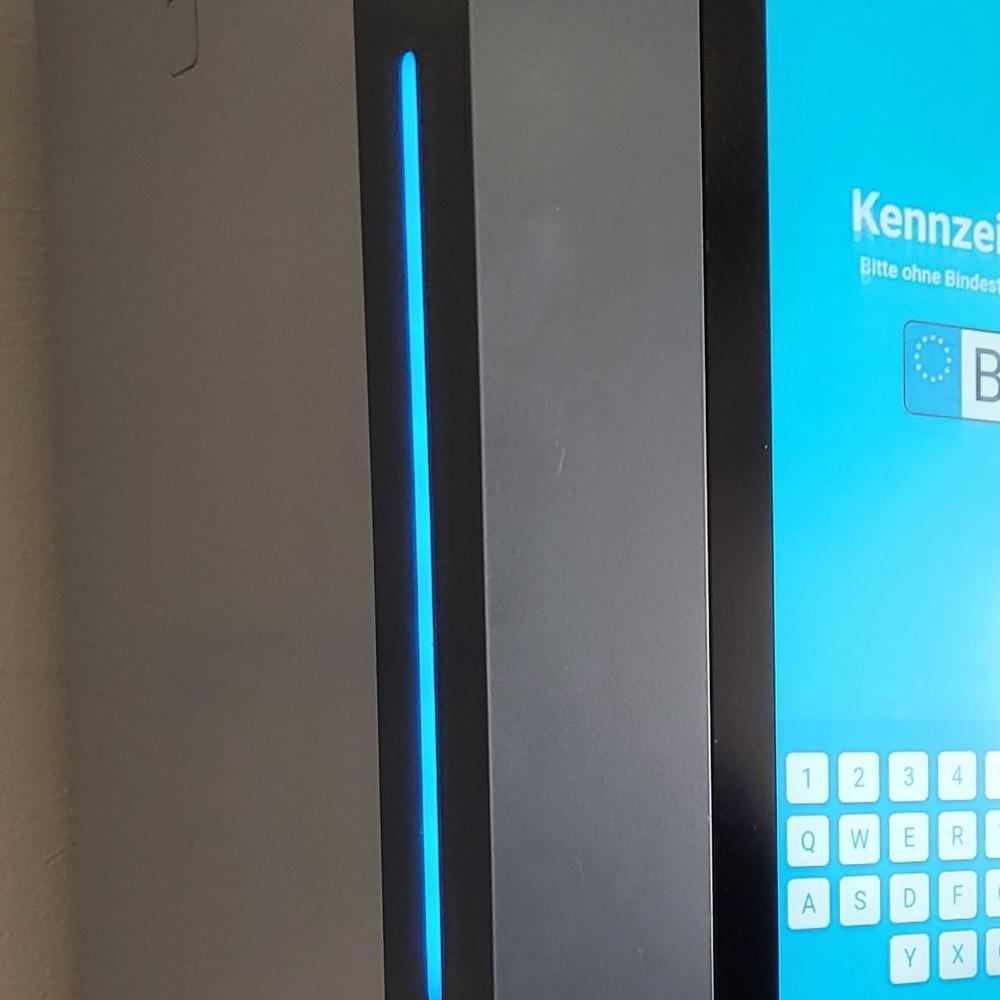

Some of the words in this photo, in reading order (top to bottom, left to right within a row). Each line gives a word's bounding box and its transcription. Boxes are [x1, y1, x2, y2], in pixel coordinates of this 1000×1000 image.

[860, 256, 898, 279] Bitte
[902, 264, 941, 285] ohne
[802, 768, 811, 788] 1
[853, 767, 865, 788] 2
[904, 766, 914, 786] 3
[952, 766, 963, 785] 4
[801, 831, 816, 853] Q
[851, 829, 870, 849] W
[904, 827, 916, 847] E
[952, 826, 964, 846] R
[801, 893, 816, 914] A
[854, 890, 867, 910] S
[904, 888, 916, 908] D
[953, 885, 964, 905] F
[904, 947, 916, 968] Y
[952, 944, 964, 965] X
